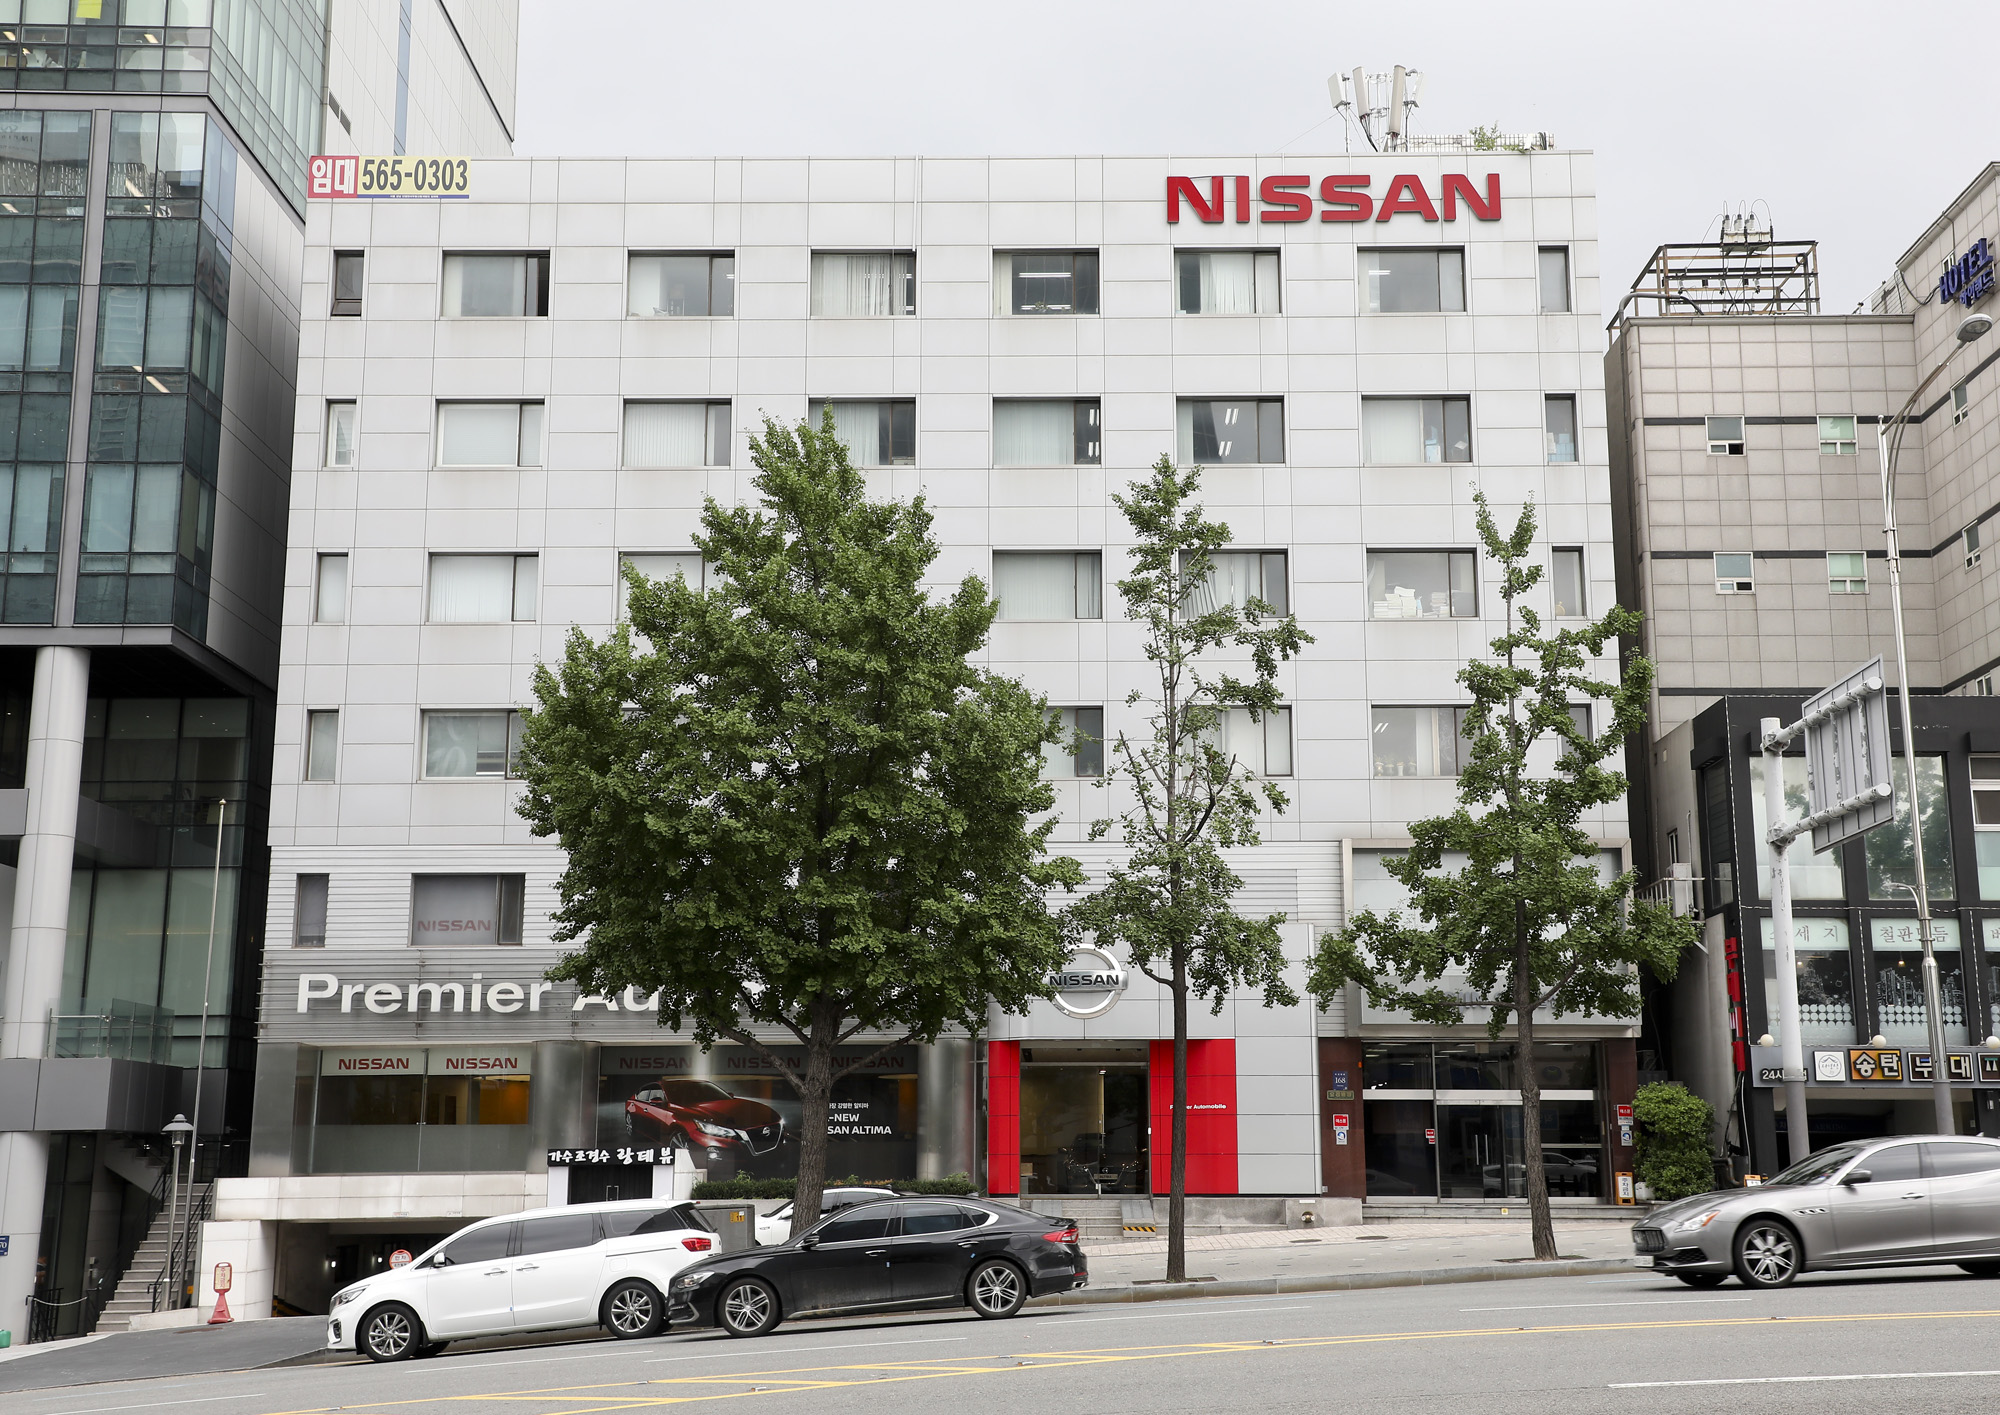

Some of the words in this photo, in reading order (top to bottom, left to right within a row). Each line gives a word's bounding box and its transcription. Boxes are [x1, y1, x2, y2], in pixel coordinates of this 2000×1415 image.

[311, 159, 355, 194] 임대
[362, 159, 468, 191] 565-0303
[1167, 173, 1501, 223] NISSAN
[1939, 238, 1993, 304] HOTEL
[418, 919, 491, 932] NISSAN
[1879, 925, 1949, 943] 철판듬
[1049, 974, 1119, 986] NISSAN
[297, 973, 553, 1014] Premier
[338, 1058, 409, 1070] NISSAN
[446, 1057, 518, 1070] NISSAN
[619, 1056, 692, 1069] NISSAN
[1854, 1053, 1899, 1078] 송탄
[828, 1113, 860, 1122] -NEW
[827, 1126, 850, 1135] SAN
[851, 1126, 892, 1135] ALTIMA
[548, 1150, 573, 1163] 가수
